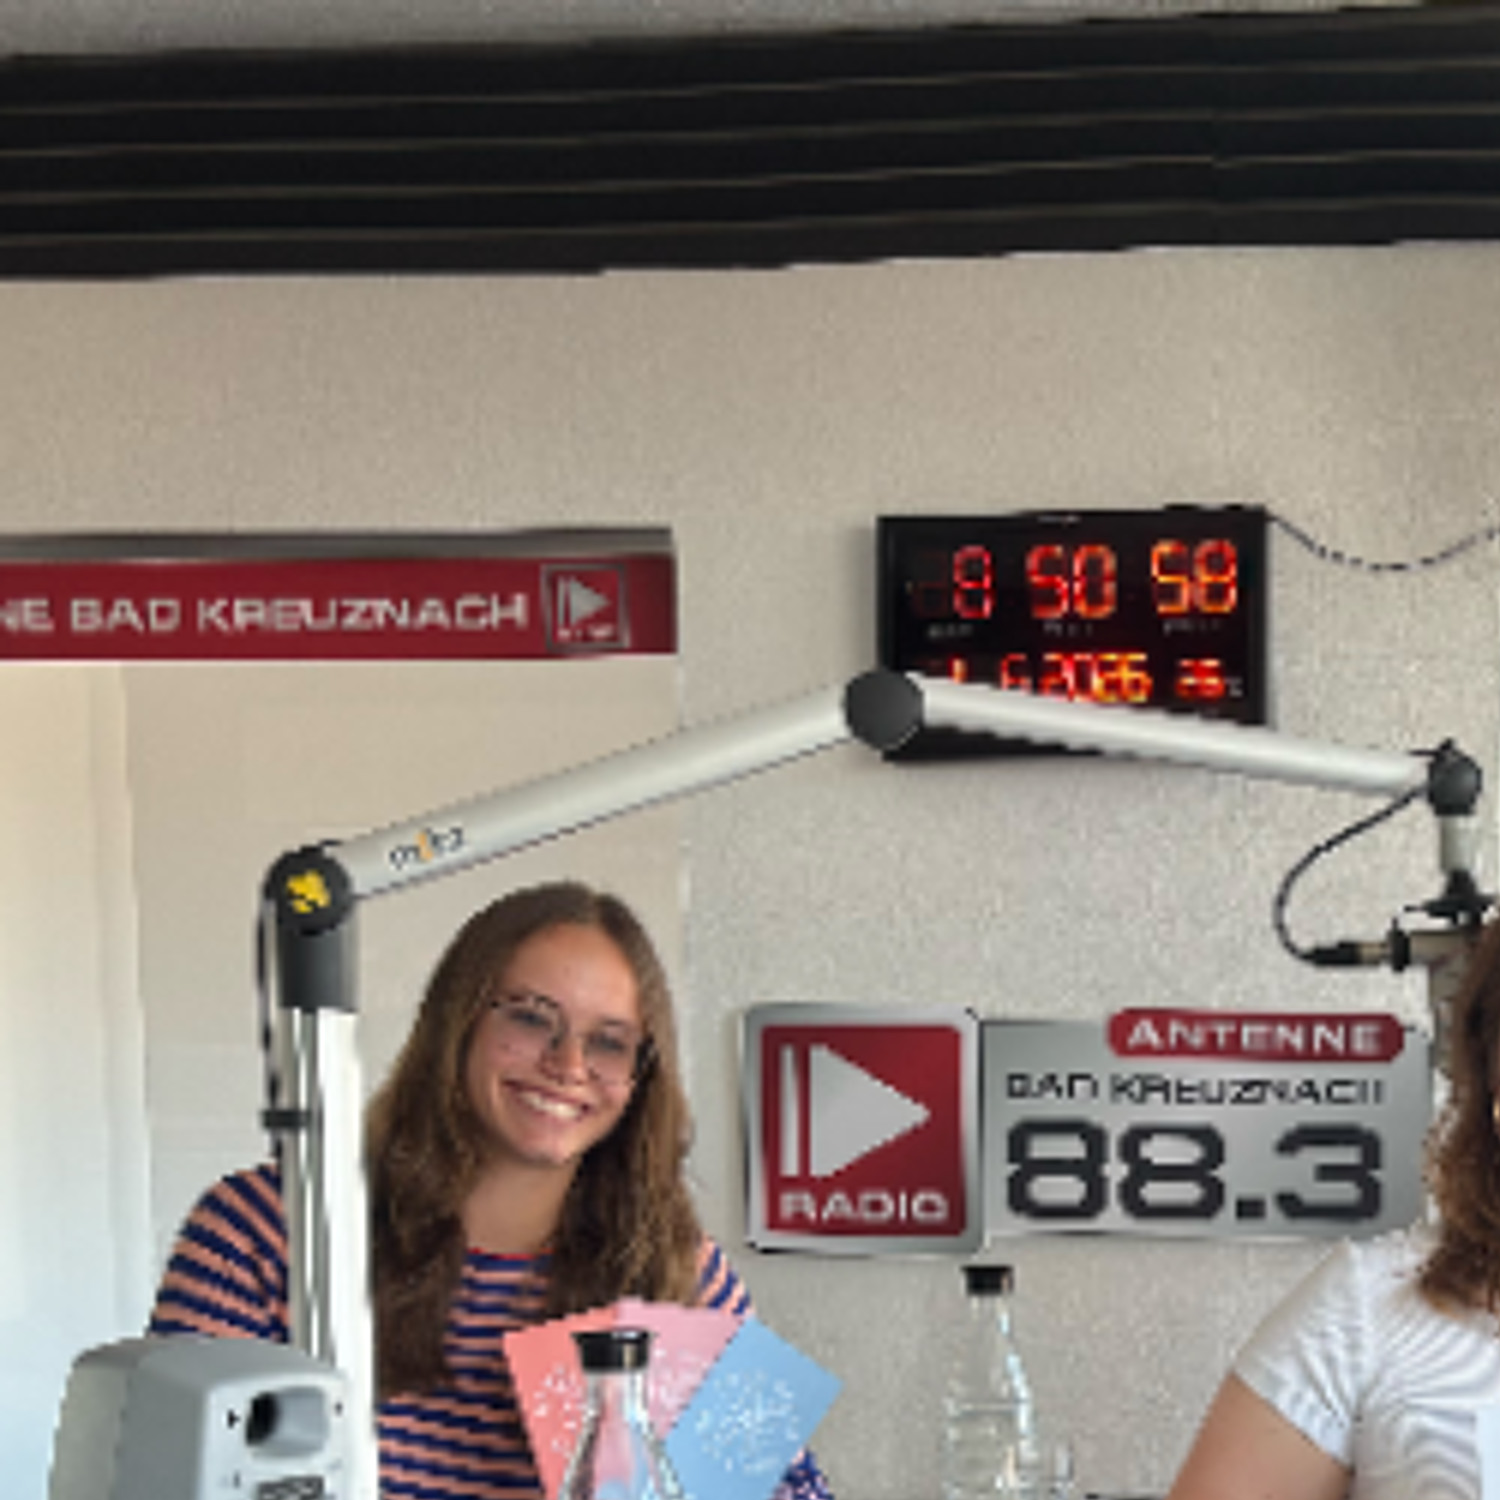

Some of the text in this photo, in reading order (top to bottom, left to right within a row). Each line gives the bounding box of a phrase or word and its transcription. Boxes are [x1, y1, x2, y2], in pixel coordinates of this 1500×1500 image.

[1025, 543, 1117, 619] 50
[1150, 538, 1239, 615] 58
[70, 598, 181, 633] BAD
[197, 593, 527, 635] KREUZNACH
[1127, 1018, 1382, 1056] ANTENNE
[1007, 1073, 1382, 1106] BAD KREUZNACH
[1007, 1119, 1382, 1221] 88.3
[779, 1190, 950, 1224] RADIO
